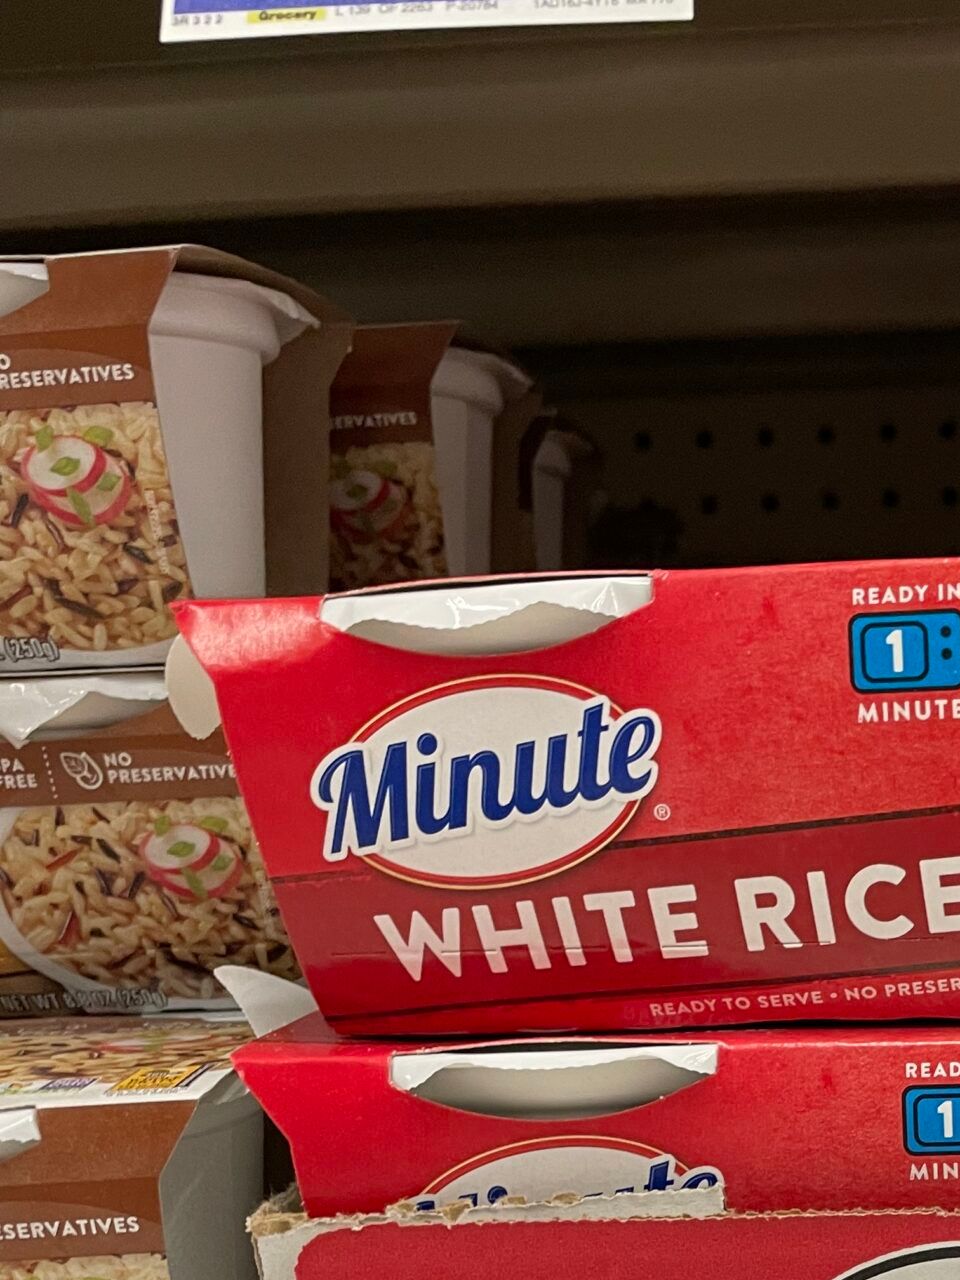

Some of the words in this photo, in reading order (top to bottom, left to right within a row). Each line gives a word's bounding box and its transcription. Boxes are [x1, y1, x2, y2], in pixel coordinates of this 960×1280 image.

[259, 10, 317, 22] Grocery
[852, 583, 928, 606] READY
[885, 628, 904, 674] 1
[103, 752, 132, 768] NO
[318, 702, 655, 855] Minute
[374, 883, 709, 983] WHITE
[650, 997, 717, 1018] READY
[721, 994, 752, 1012] TO
[757, 989, 824, 1009] SERVE
[844, 984, 878, 1001] NO
[935, 1100, 954, 1138] 1
